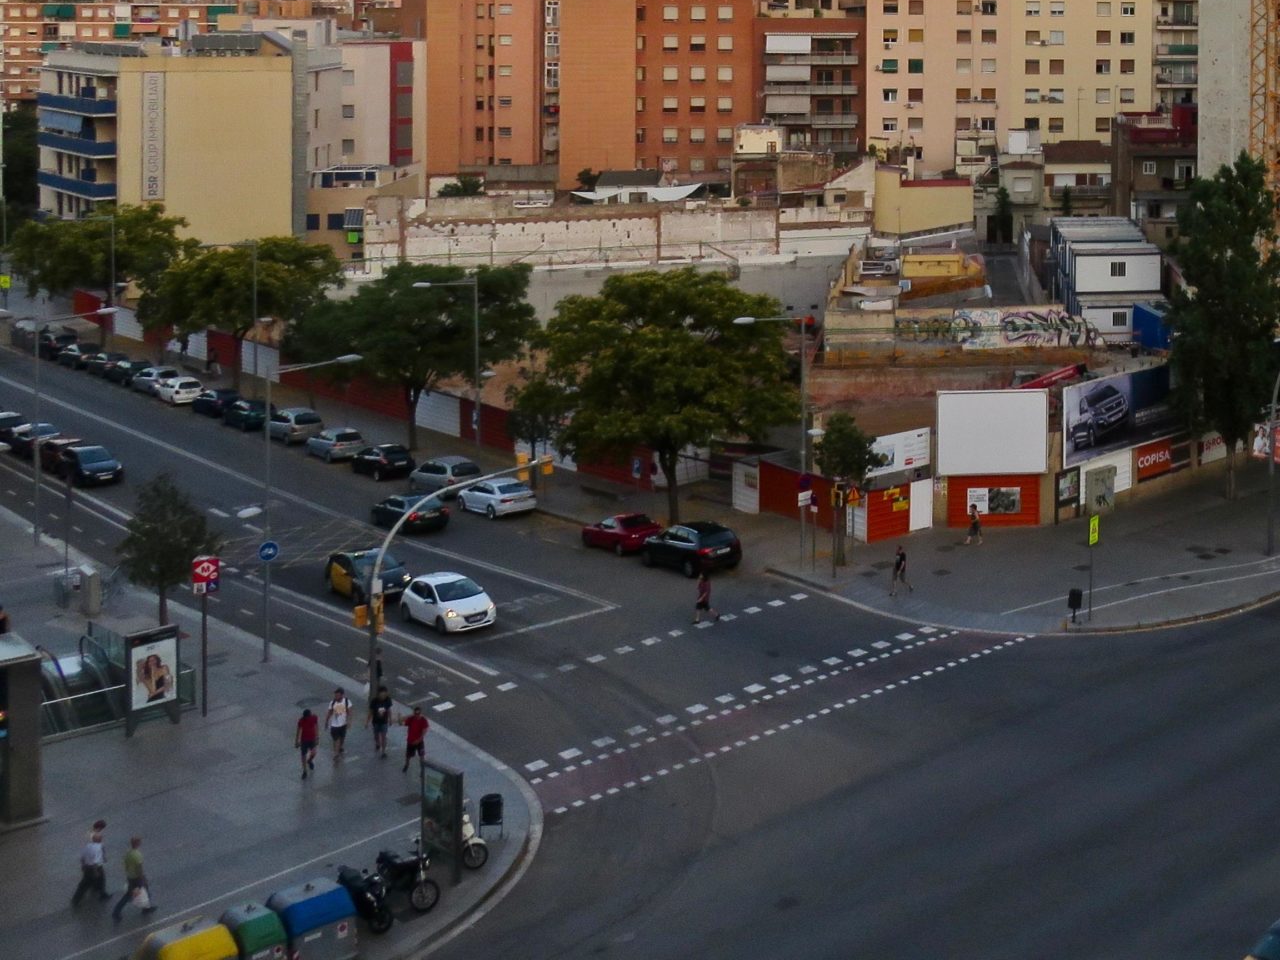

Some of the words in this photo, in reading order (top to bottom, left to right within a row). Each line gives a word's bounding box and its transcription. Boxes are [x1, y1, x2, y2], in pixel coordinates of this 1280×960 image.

[148, 76, 159, 142] IMMOBILIARI
[148, 144, 159, 173] GRUP
[1137, 449, 1171, 469] COPISA
